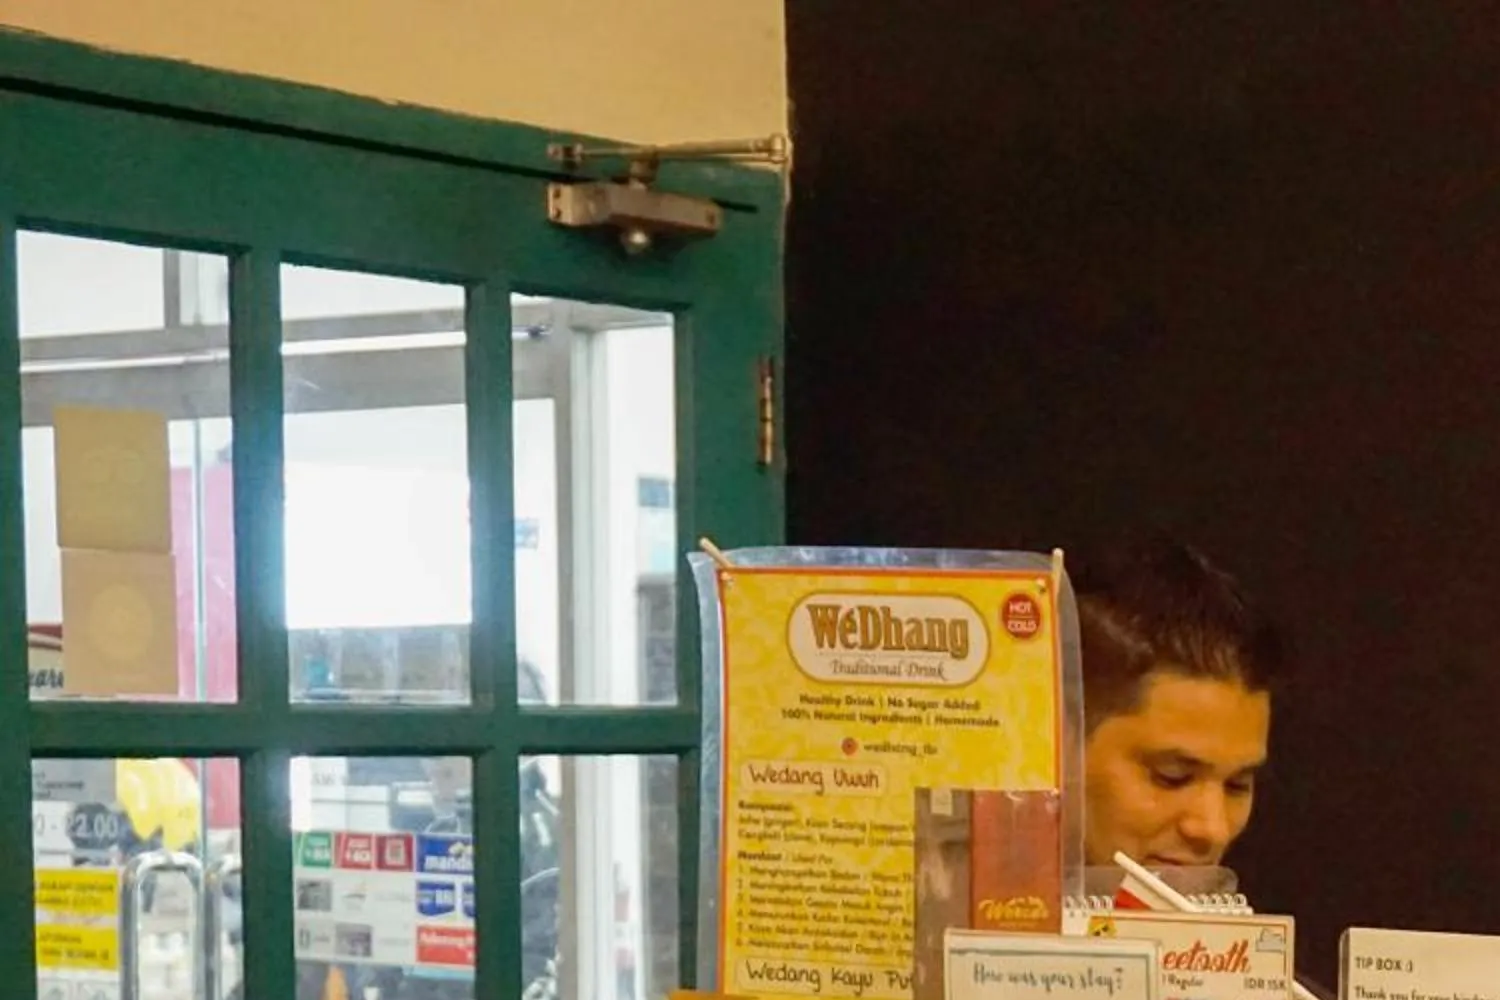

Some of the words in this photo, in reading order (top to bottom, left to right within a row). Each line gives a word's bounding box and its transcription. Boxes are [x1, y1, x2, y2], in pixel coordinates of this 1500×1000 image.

[1008, 601, 1033, 614] HOT
[1006, 619, 1038, 633] COLD
[830, 658, 904, 677] Traditional
[905, 660, 949, 681] Drink
[799, 693, 842, 707] Healthy
[845, 694, 875, 707] Drink
[887, 695, 904, 708] No
[907, 697, 940, 711] Sugar
[943, 698, 980, 711] Added
[813, 709, 856, 721] Natural
[859, 711, 922, 725] Ingredients
[934, 714, 999, 727] Homemade
[748, 764, 824, 795] Wedang
[833, 768, 881, 789] Uwuh
[424, 855, 474, 872] mandi
[1162, 939, 1251, 973] eetooth
[1354, 956, 1373, 970] TIP
[1376, 958, 1402, 971] BOX
[745, 959, 822, 993] Wedang
[831, 967, 874, 997] Kayu
[884, 969, 914, 990] Pu
[973, 961, 1003, 985] How
[1008, 970, 1038, 987] was
[1041, 972, 1075, 993] your
[1079, 965, 1124, 996] stay?
[1354, 986, 1387, 1000] Thank
